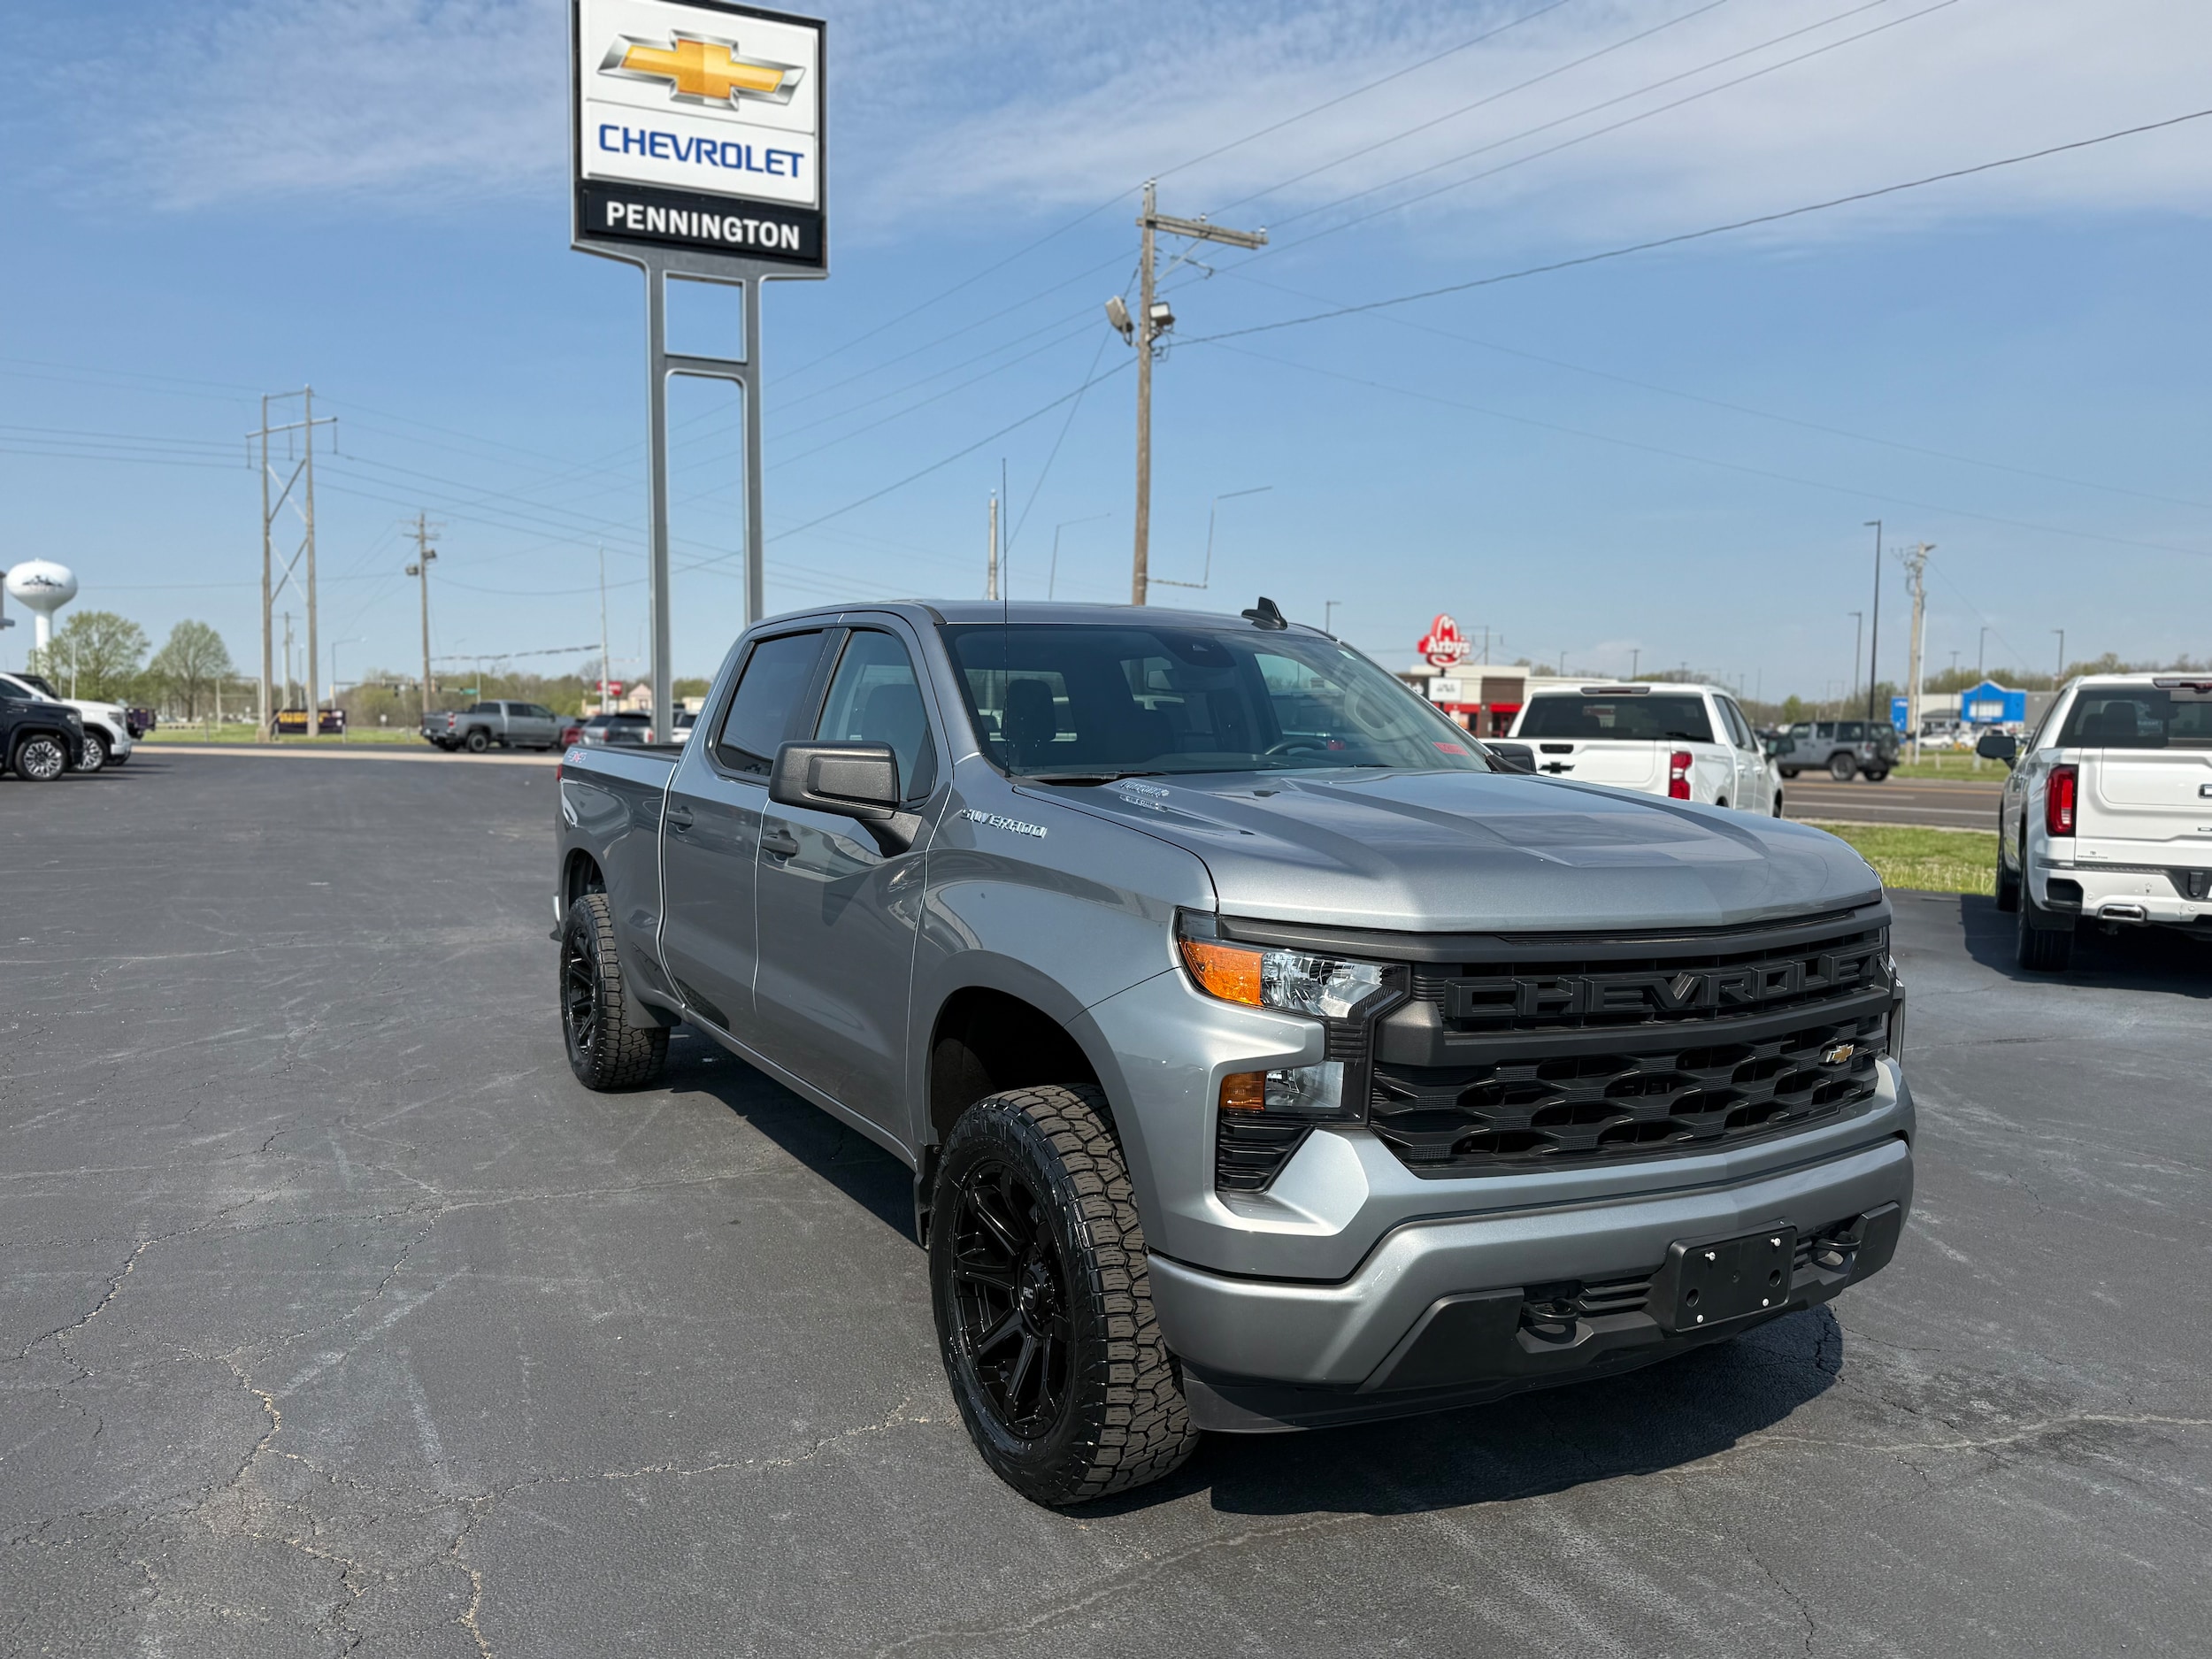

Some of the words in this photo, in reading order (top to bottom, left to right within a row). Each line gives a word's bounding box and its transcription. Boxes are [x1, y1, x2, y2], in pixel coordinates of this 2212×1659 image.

[600, 124, 804, 178] CHEVROLET
[606, 201, 799, 250] PENNINGTON
[1427, 636, 1470, 657] Arby's
